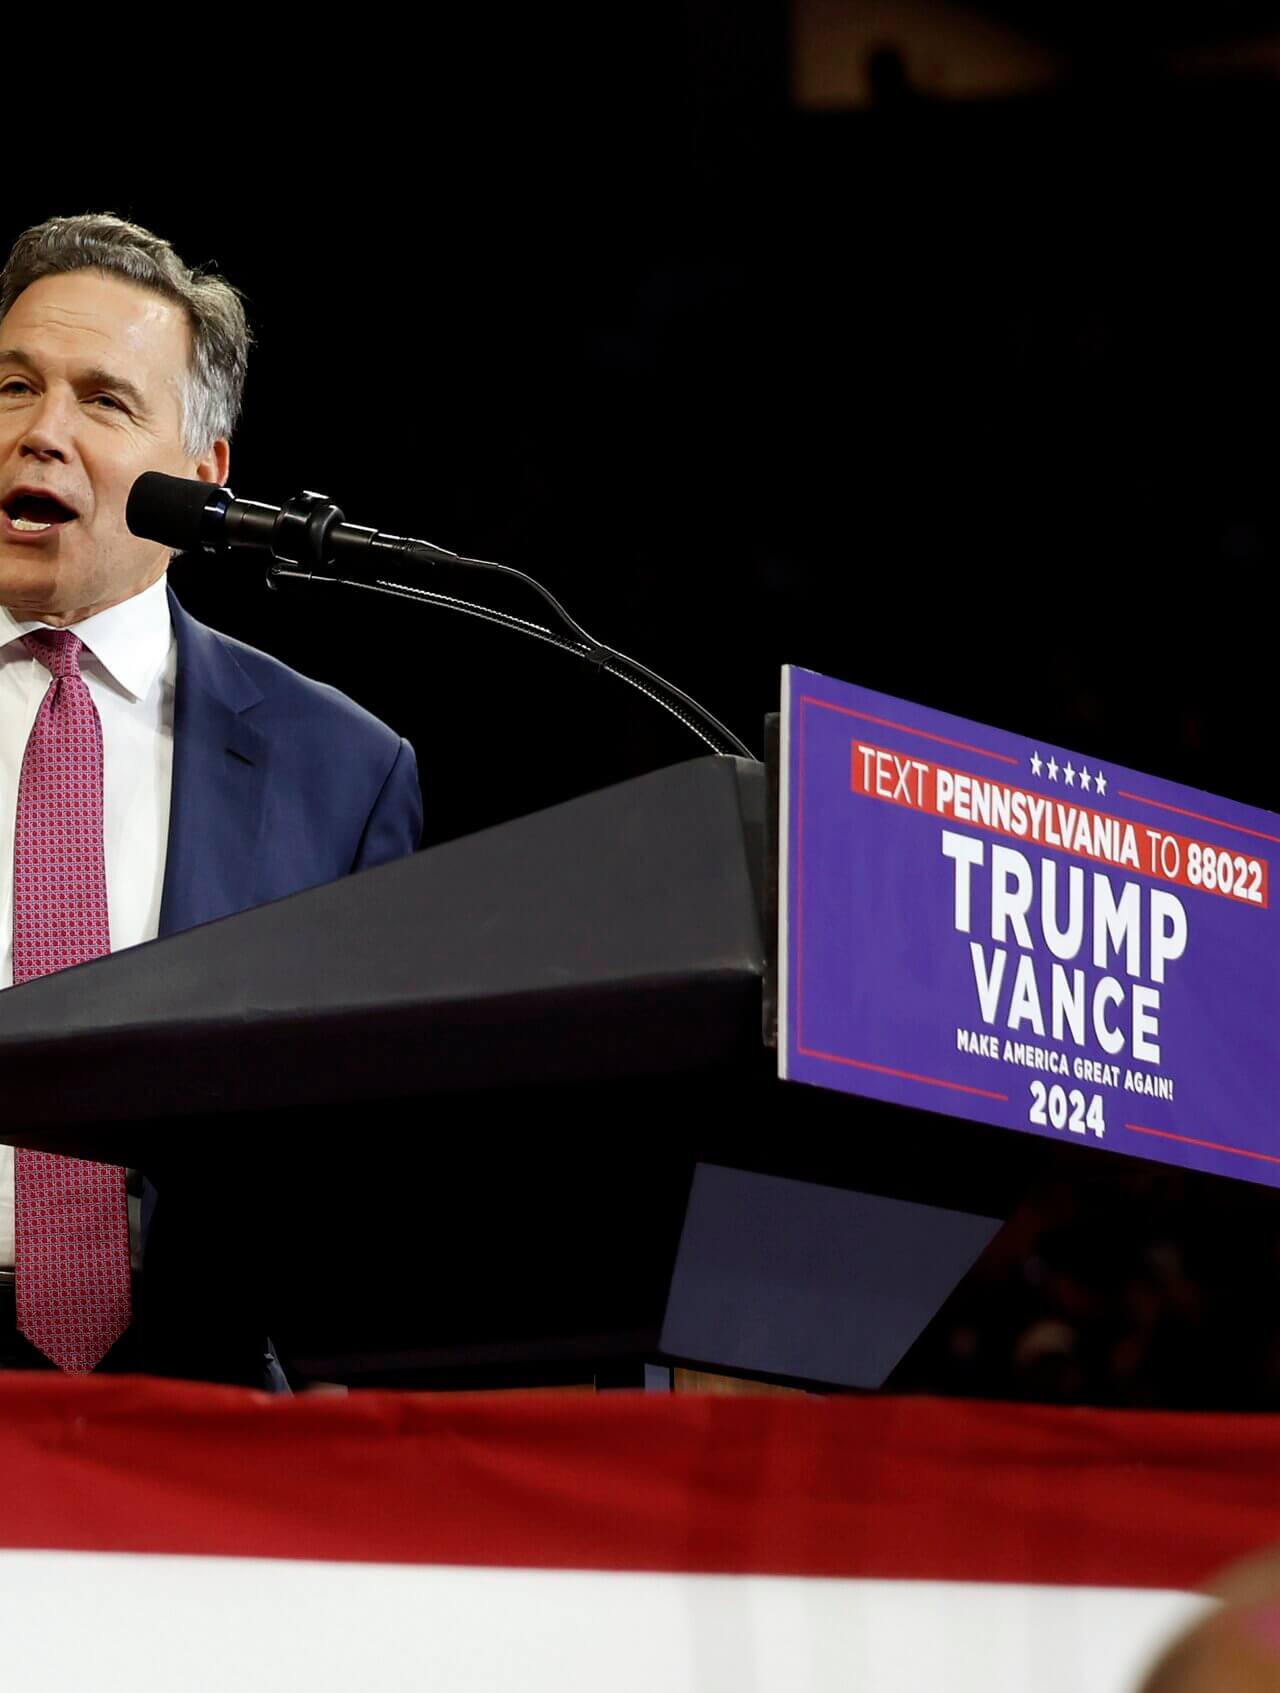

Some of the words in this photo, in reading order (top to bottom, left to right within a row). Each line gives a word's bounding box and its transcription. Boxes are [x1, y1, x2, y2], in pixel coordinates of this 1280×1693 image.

[858, 745, 929, 807] TEXT
[936, 768, 1141, 869] PENNSYLVANIA
[1146, 829, 1181, 880] TO
[1186, 842, 1264, 904] 88022
[941, 829, 1188, 984] TRUMP
[956, 1028, 999, 1060] MAKE
[1003, 1039, 1070, 1077] AMERICA
[1074, 1057, 1121, 1088] GREAT
[1124, 1069, 1174, 1101] AGAIN!
[969, 941, 1161, 1065] VANCE
[1029, 1080, 1106, 1139] 2024
